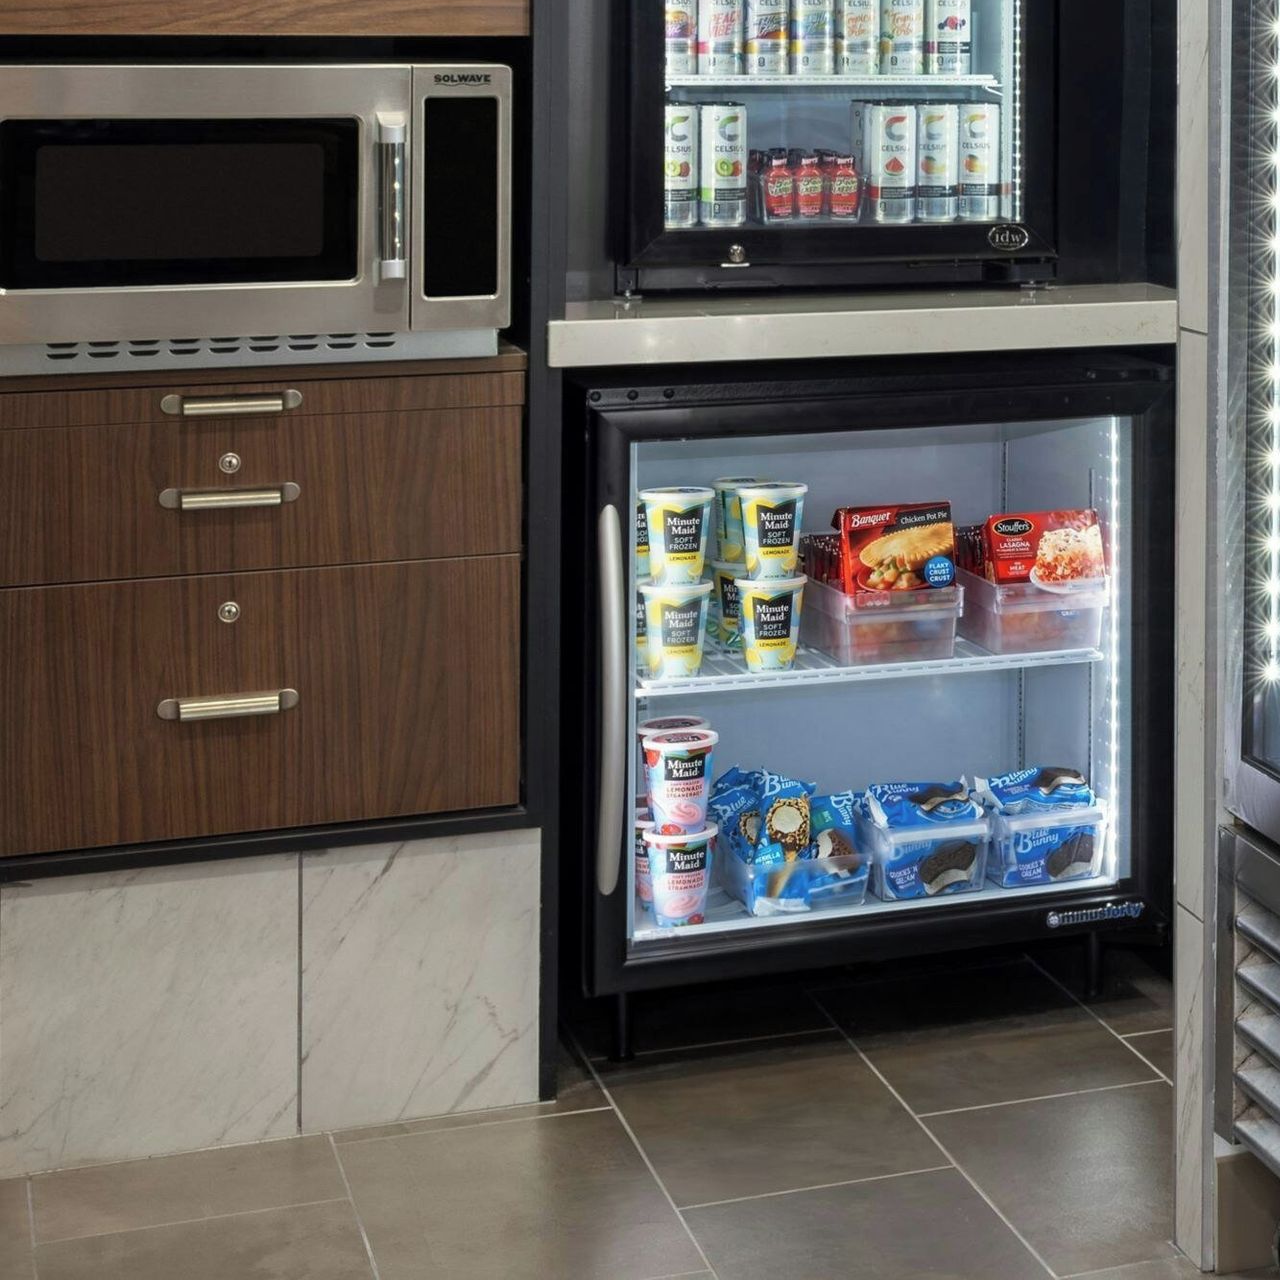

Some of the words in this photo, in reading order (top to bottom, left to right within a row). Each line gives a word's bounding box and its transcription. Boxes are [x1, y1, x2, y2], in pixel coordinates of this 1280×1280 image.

[434, 73, 491, 83] SOLWAVE
[667, 516, 700, 527] Minute
[759, 511, 793, 522] Minute
[851, 511, 891, 528] Banquet
[900, 514, 926, 524] Chicken
[926, 512, 937, 522] Pot
[937, 511, 948, 520] Pie
[764, 520, 790, 530] Maid
[997, 521, 1030, 533] Stouffer's
[671, 526, 697, 535] Maid
[673, 536, 694, 544] SOFT
[762, 537, 791, 545] FROZEN
[999, 541, 1030, 549] LASAGNA
[928, 562, 950, 570] FLAKY
[929, 567, 951, 576] CRUST
[929, 574, 952, 582] CRUST
[756, 604, 789, 614] Minute
[664, 610, 698, 620] Minute
[760, 613, 786, 623] Maid
[668, 619, 693, 629] Maid
[763, 623, 782, 631] SOFT
[758, 629, 787, 637] FROZEN
[667, 758, 703, 770] Minute
[671, 767, 699, 778] Maid
[669, 851, 705, 862] Minute
[673, 860, 700, 871] Maid
